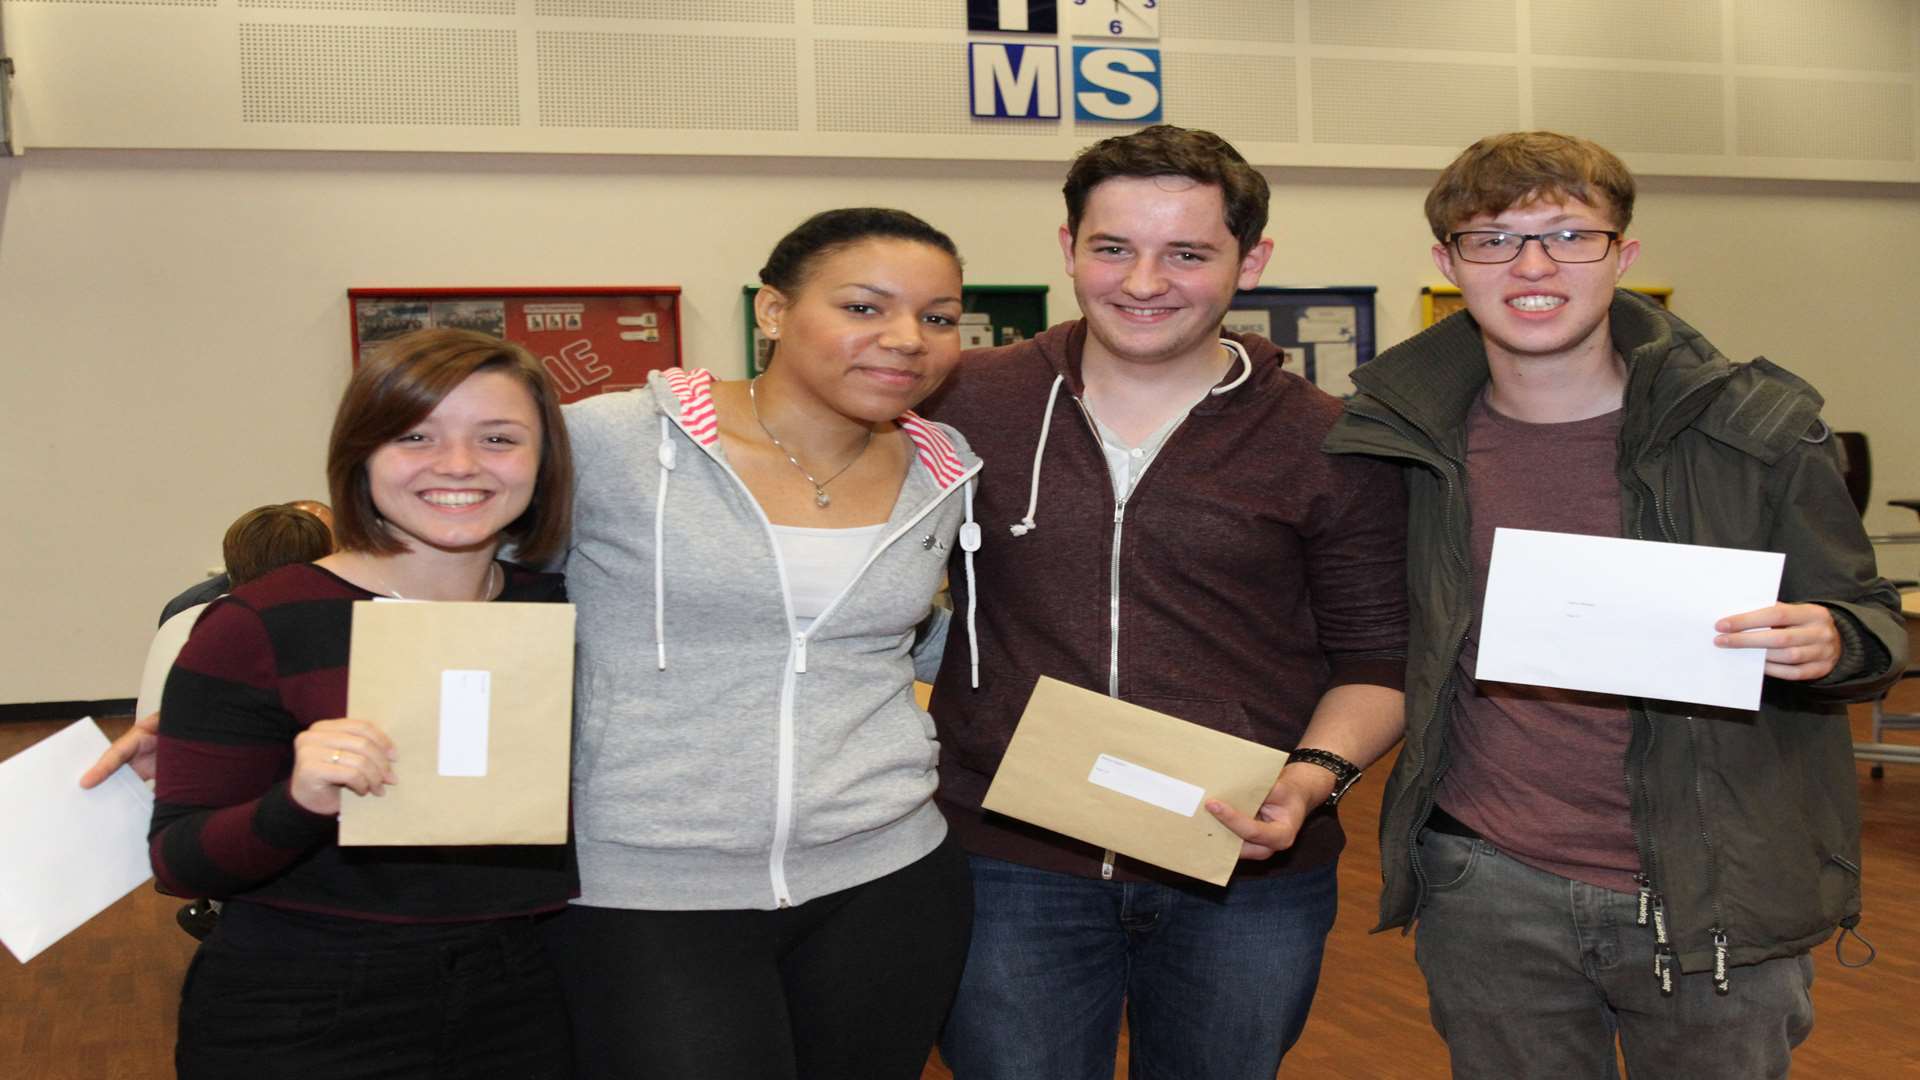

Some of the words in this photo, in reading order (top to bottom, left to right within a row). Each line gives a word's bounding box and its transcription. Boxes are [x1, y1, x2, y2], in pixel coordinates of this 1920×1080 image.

[1109, 20, 1123, 35] 6
[542, 339, 613, 394] IE
[1638, 892, 1649, 925] Superdry
[1654, 911, 1667, 944] Superdry
[1715, 947, 1727, 980] Superdry
